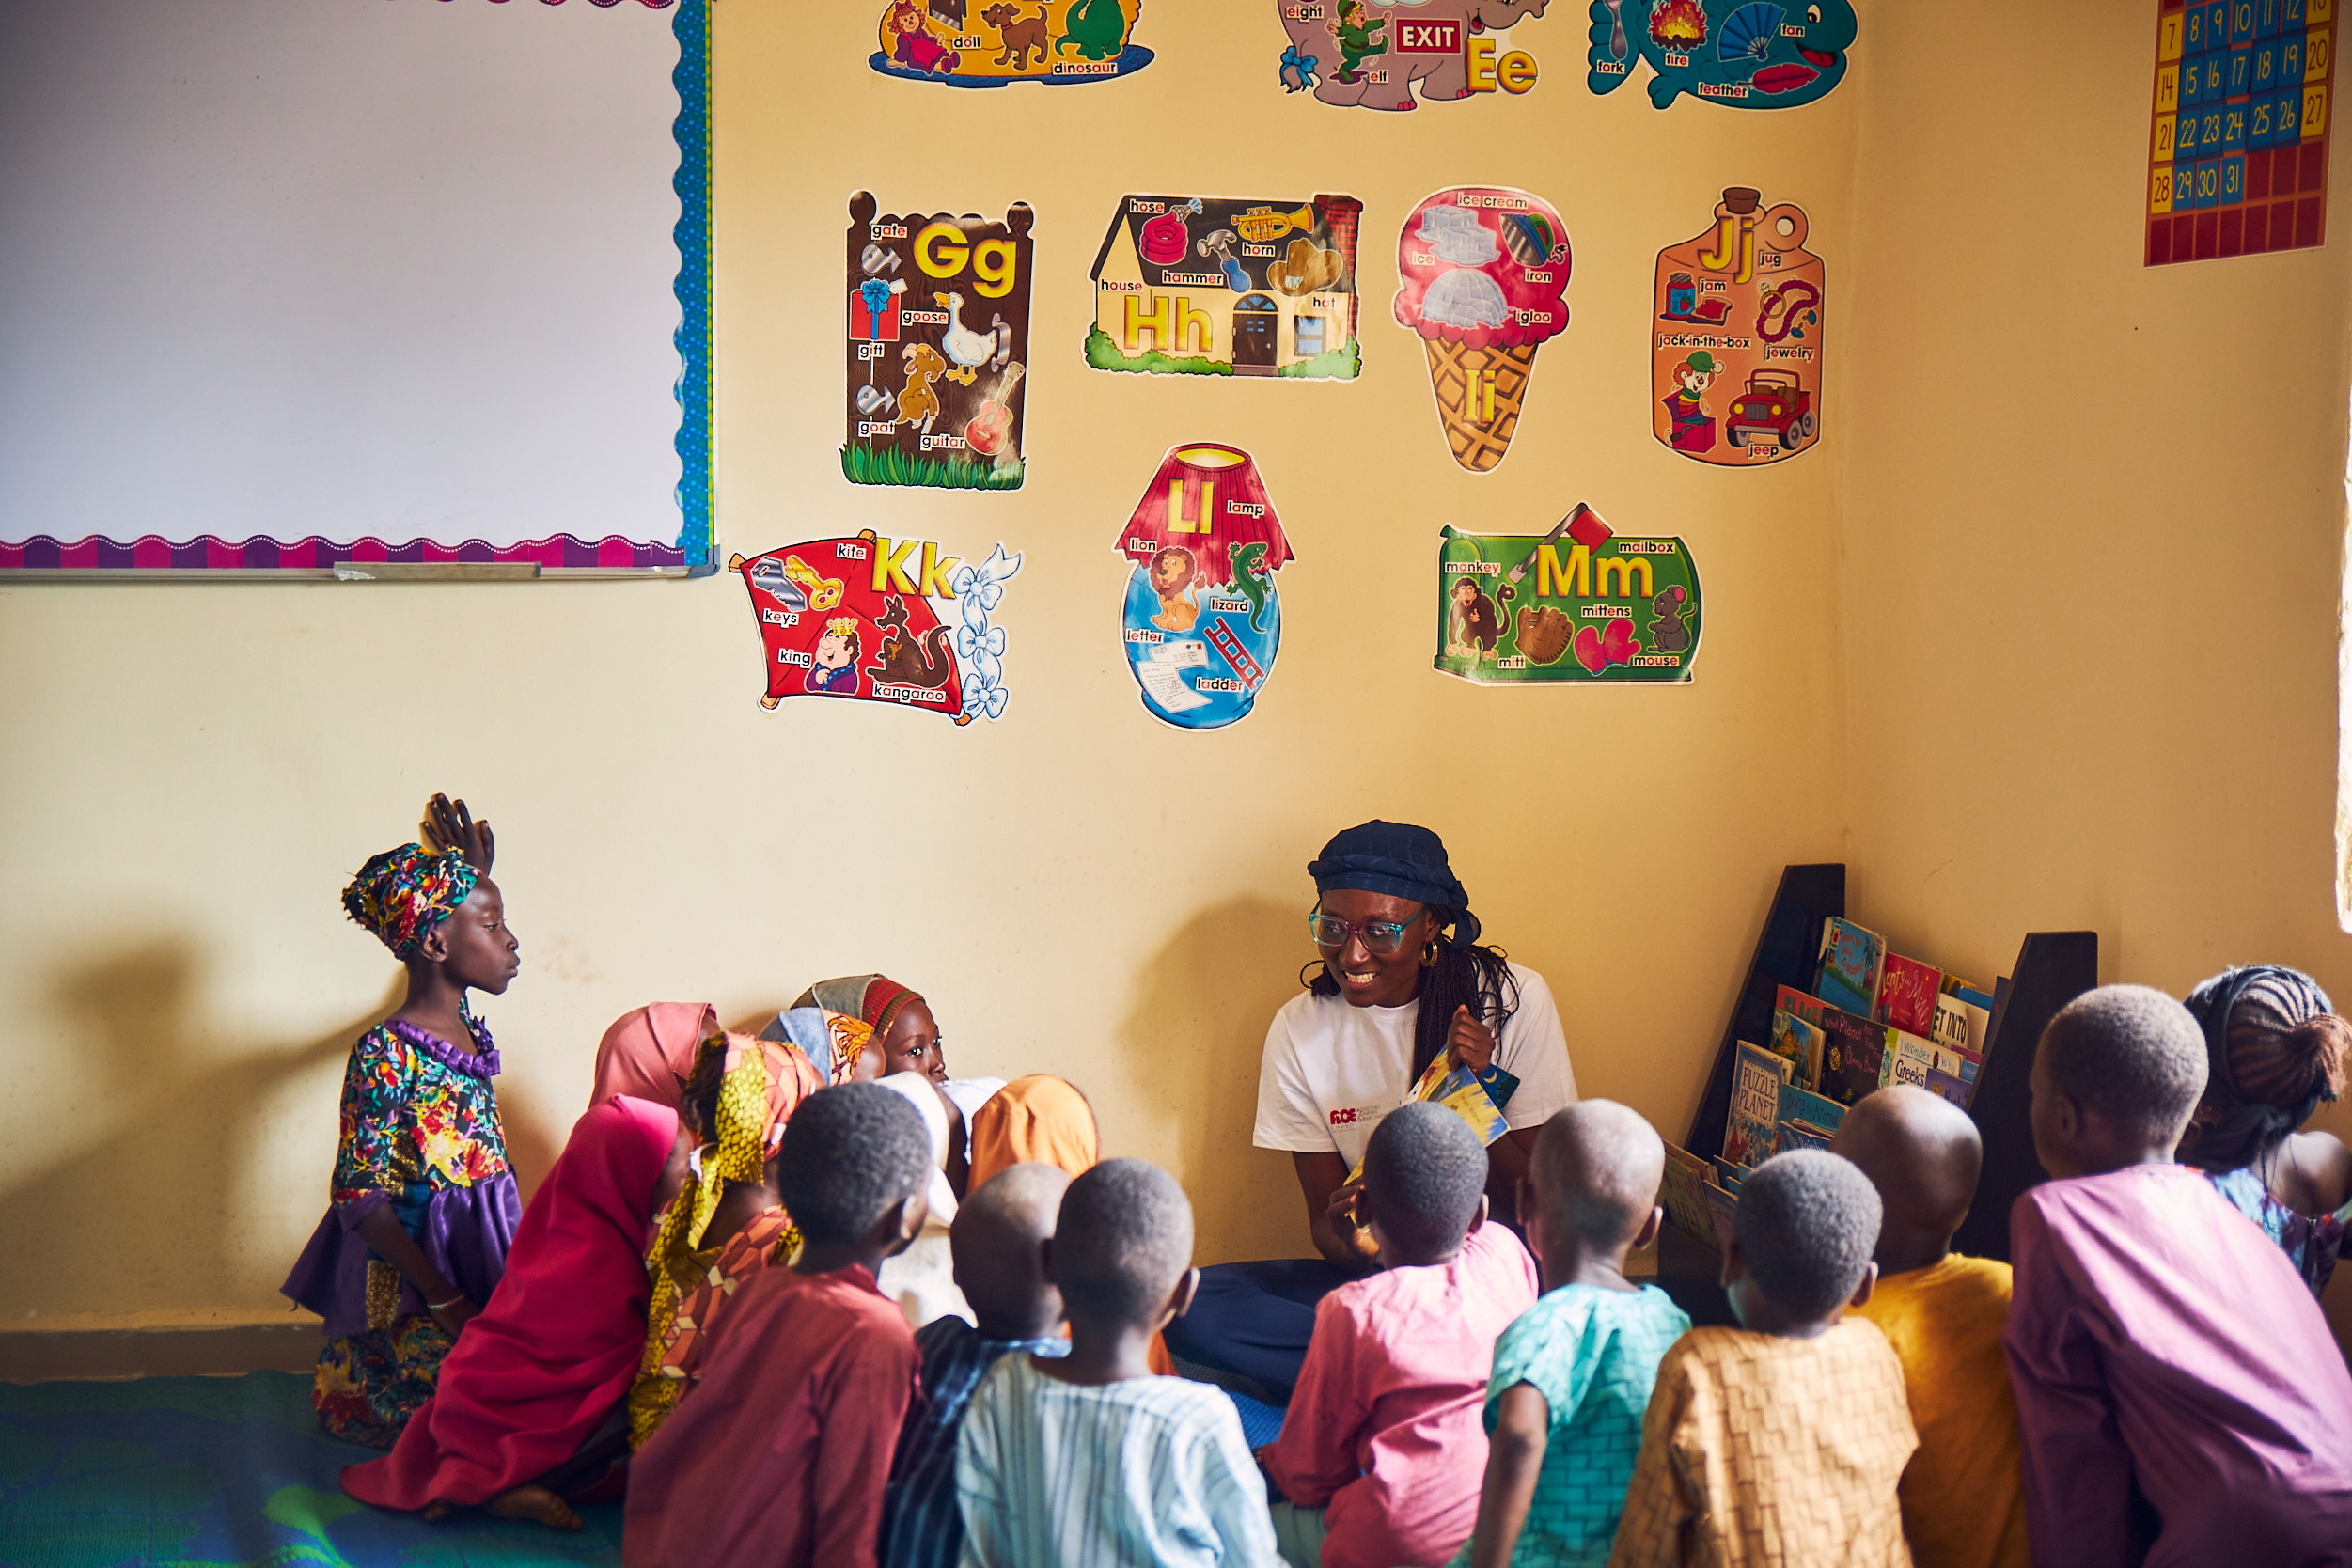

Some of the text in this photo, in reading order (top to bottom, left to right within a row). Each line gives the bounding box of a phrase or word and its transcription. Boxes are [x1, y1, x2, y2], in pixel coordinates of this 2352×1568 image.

[1287, 6, 1323, 20] eight
[1781, 24, 1804, 36] fan
[2169, 0, 2299, 50] 7 8 9 10 11 12
[953, 37, 980, 48] doll
[1403, 26, 1455, 47] EXIT
[1467, 39, 1538, 94] Ee
[1598, 61, 1623, 72] fork
[1667, 55, 1687, 66] fire
[1054, 63, 1117, 74] dinosaur
[2162, 39, 2327, 102] 14 15 16 17 18 19 20
[1371, 71, 1388, 82] elf
[1700, 83, 1748, 97] feather
[2159, 95, 2323, 151] 21 22 23 24 25 26 27
[2154, 164, 2239, 203] 28 29 30 31
[1131, 199, 1164, 212] hose
[1459, 193, 1528, 208] ice cream
[872, 225, 906, 239] gate
[1243, 243, 1275, 257] horn
[1698, 217, 1754, 284] Jj
[914, 223, 1016, 298] Gg
[1413, 251, 1434, 264] ice
[1760, 252, 1781, 266] jug
[1163, 271, 1223, 285] hammer
[1525, 269, 1551, 282] iron
[1101, 279, 1143, 291] house
[1700, 279, 1726, 292] jam
[1313, 296, 1336, 308] hat
[902, 311, 948, 324] goose
[1515, 308, 1550, 324] igloo
[1124, 295, 1213, 352] Hh
[1658, 334, 1749, 348] jack-in-the-box
[860, 344, 884, 358] gift
[1766, 346, 1813, 360] jewelry
[1462, 369, 1496, 423] Ii
[860, 421, 895, 436] goat
[922, 435, 965, 449] guitar
[1748, 444, 1779, 458] jeep
[1228, 500, 1264, 517] lamp
[839, 543, 865, 557] kite
[1131, 539, 1156, 552] lion
[1619, 541, 1674, 554] mailbox
[871, 537, 961, 599] Kk
[1446, 562, 1499, 576] monkey
[1536, 544, 1654, 598] Mm
[1211, 598, 1248, 612] lizard
[1582, 606, 1630, 617] mittens
[765, 609, 797, 627] keys
[1126, 630, 1163, 642] letter
[779, 650, 811, 666] king
[1499, 657, 1525, 668] mitt
[1634, 656, 1678, 666] mouse
[1197, 678, 1243, 691] ladder
[874, 684, 945, 702] kangaroo
[1946, 1011, 1967, 1044] INTO
[1905, 1041, 1931, 1061] Wonder
[1895, 1059, 1925, 1087] Greeks
[1743, 1066, 1776, 1100] PUZZLE
[1739, 1089, 1775, 1122] PLANET
